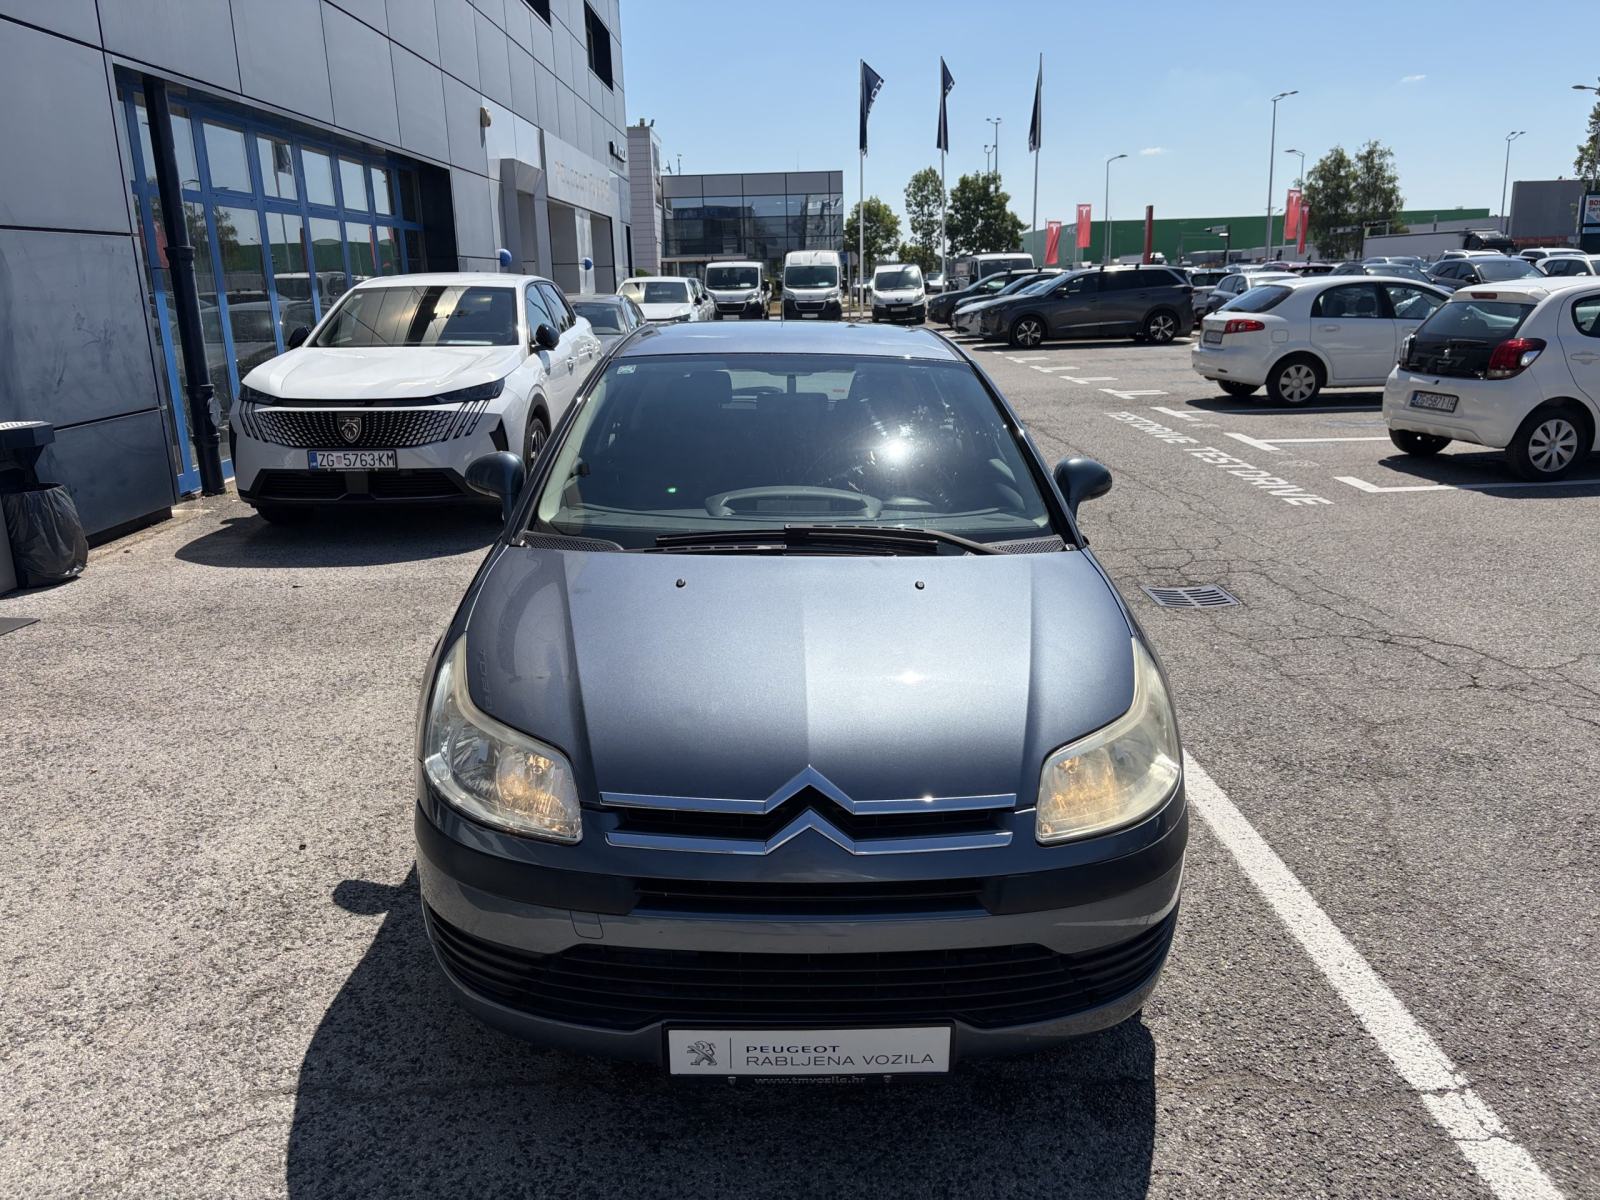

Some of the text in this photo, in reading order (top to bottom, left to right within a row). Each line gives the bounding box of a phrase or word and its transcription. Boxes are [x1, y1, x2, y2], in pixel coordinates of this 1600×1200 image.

[318, 453, 335, 467] ZG
[746, 1045, 840, 1054] PEUGEOT
[746, 1053, 935, 1067] RABLJENA VOZILA
